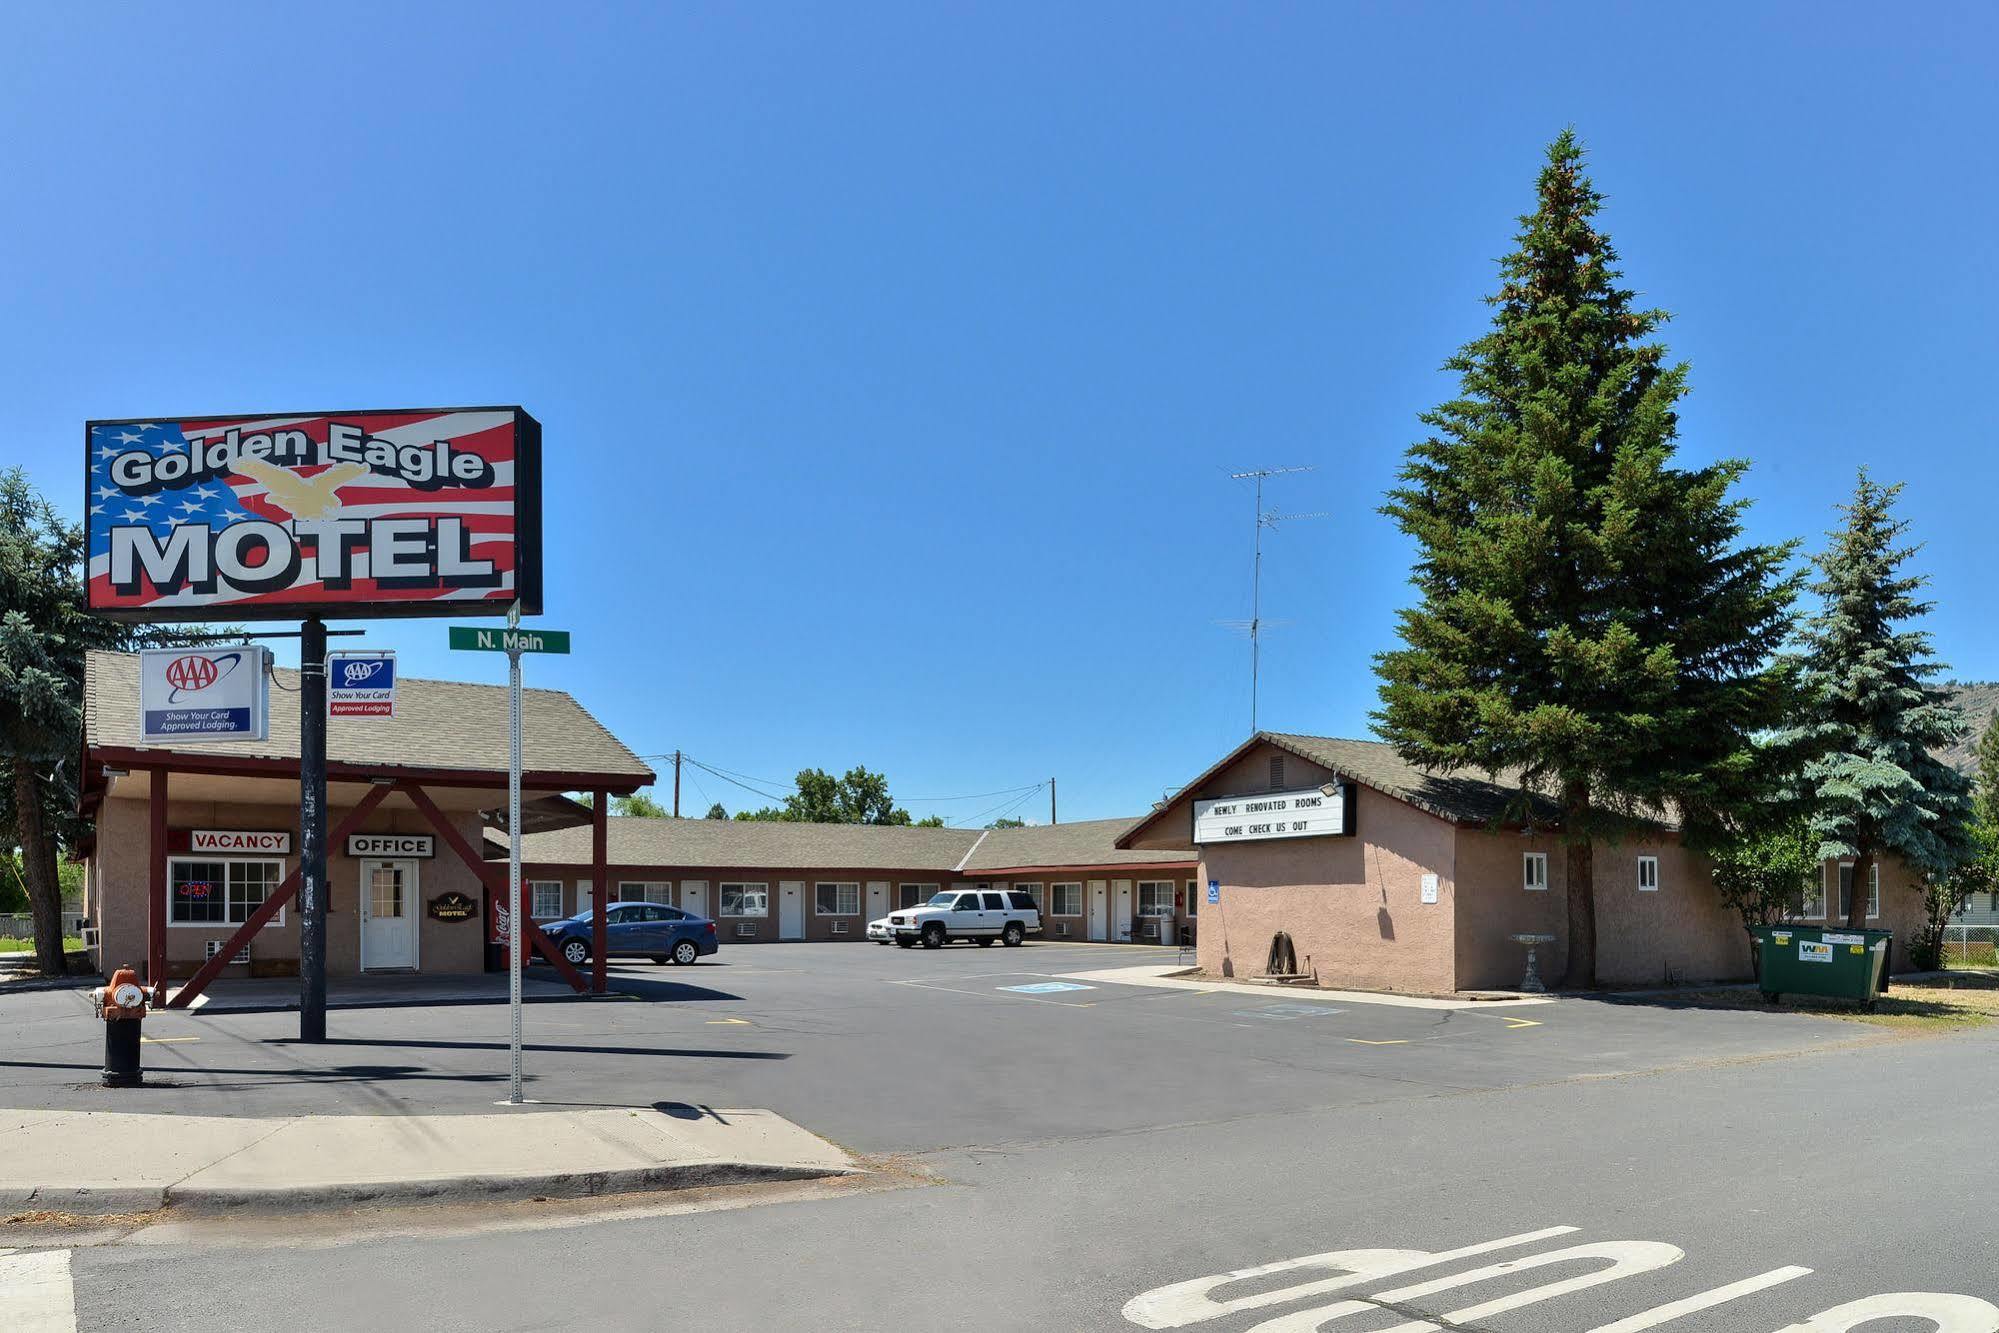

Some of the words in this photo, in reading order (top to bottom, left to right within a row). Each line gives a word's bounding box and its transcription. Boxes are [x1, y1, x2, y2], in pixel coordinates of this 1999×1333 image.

[110, 426, 308, 486] Golden
[328, 423, 484, 482] Eagle
[110, 518, 495, 586] MOTEL
[477, 631, 496, 648] N.
[503, 632, 544, 650] Main
[168, 656, 217, 690] AAA
[346, 663, 370, 680] AAA
[332, 690, 354, 699] Show
[355, 690, 372, 699] Your
[372, 690, 391, 699] Card
[166, 712, 189, 722] Show
[191, 711, 209, 720] Your
[210, 710, 230, 719] Card
[332, 704, 363, 713] Approved
[364, 704, 391, 713] Lodging
[160, 721, 201, 732] Approved
[1214, 804, 1237, 816] NEWLY
[1245, 800, 1287, 813] RENOVATED
[1295, 797, 1322, 809] ROOMS
[1224, 825, 1243, 836] COME
[1248, 824, 1271, 834] CHECK
[1276, 822, 1286, 832] US
[1292, 820, 1308, 831] OUT
[195, 834, 284, 850] VACANCY
[354, 839, 427, 853] OFFICE
